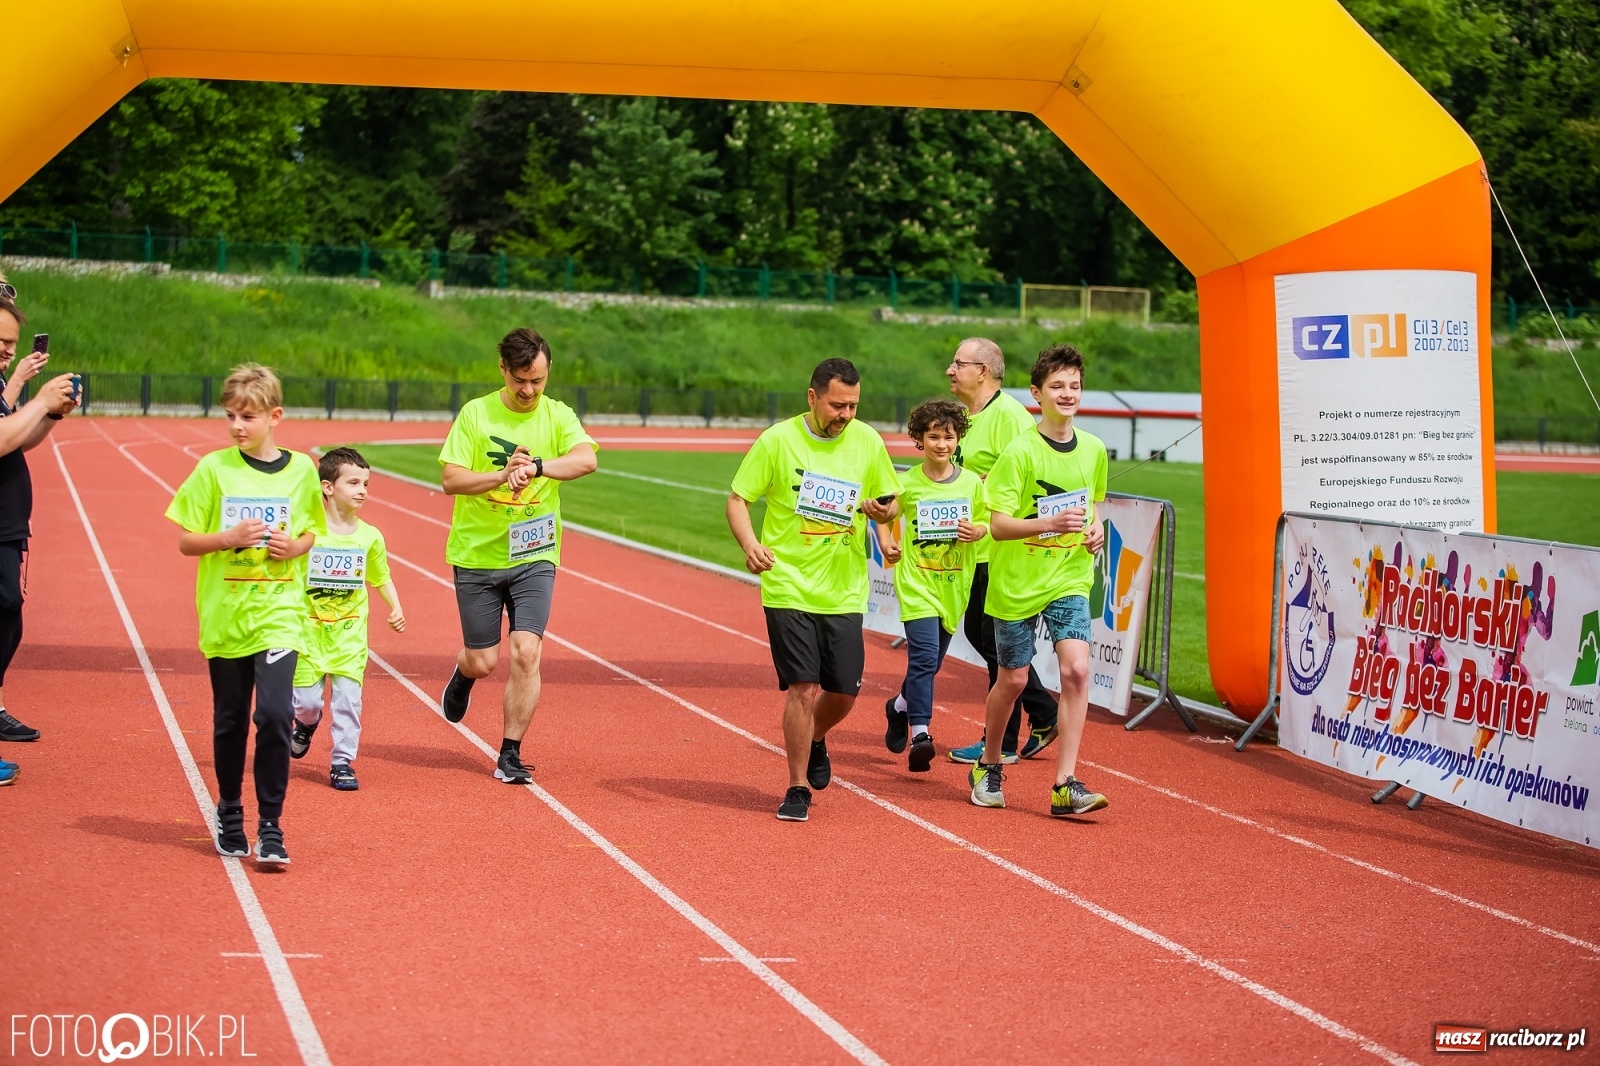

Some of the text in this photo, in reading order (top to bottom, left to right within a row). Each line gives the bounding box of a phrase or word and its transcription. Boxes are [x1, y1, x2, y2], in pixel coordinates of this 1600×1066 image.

[1301, 324, 1342, 351] cz
[1363, 314, 1397, 358] pl
[1319, 410, 1352, 421] Projekt
[1364, 410, 1403, 418] numerze
[1405, 409, 1461, 419] rejestracyjnym
[1293, 434, 1309, 443] PL.
[1311, 431, 1399, 442] 3.22/3.304/09.01281
[1402, 432, 1416, 441] pn:
[1442, 431, 1454, 439] bez
[1301, 456, 1318, 466] jest
[1320, 453, 1406, 465] współfinansowany
[1418, 453, 1435, 462] 85%
[1447, 452, 1473, 461] środków
[1319, 475, 1463, 487] Europejskiego Funduszu Rozwoju
[815, 485, 845, 504] 003
[849, 489, 857, 498] R
[1080, 495, 1086, 503] R
[280, 506, 287, 515] R
[962, 505, 968, 513] R
[1310, 500, 1375, 511] Regionalnego
[1399, 498, 1411, 507] do
[1413, 498, 1430, 506] 10%
[1442, 497, 1470, 506] środków
[240, 506, 275, 523] 008
[931, 506, 958, 520] 098
[547, 519, 553, 528] R
[521, 526, 545, 543] 081
[324, 555, 352, 569] 078
[356, 555, 363, 564] R
[1380, 565, 1523, 652] Raciborski
[1348, 635, 1400, 724] Bieg
[1403, 643, 1450, 717] bez
[1453, 658, 1549, 740] Barier
[1565, 695, 1594, 715] powiat
[1563, 718, 1588, 733] zielona
[1311, 705, 1325, 736] dla
[1474, 751, 1486, 780] i
[1480, 753, 1505, 787] ich
[1505, 764, 1589, 811] opiekunów
